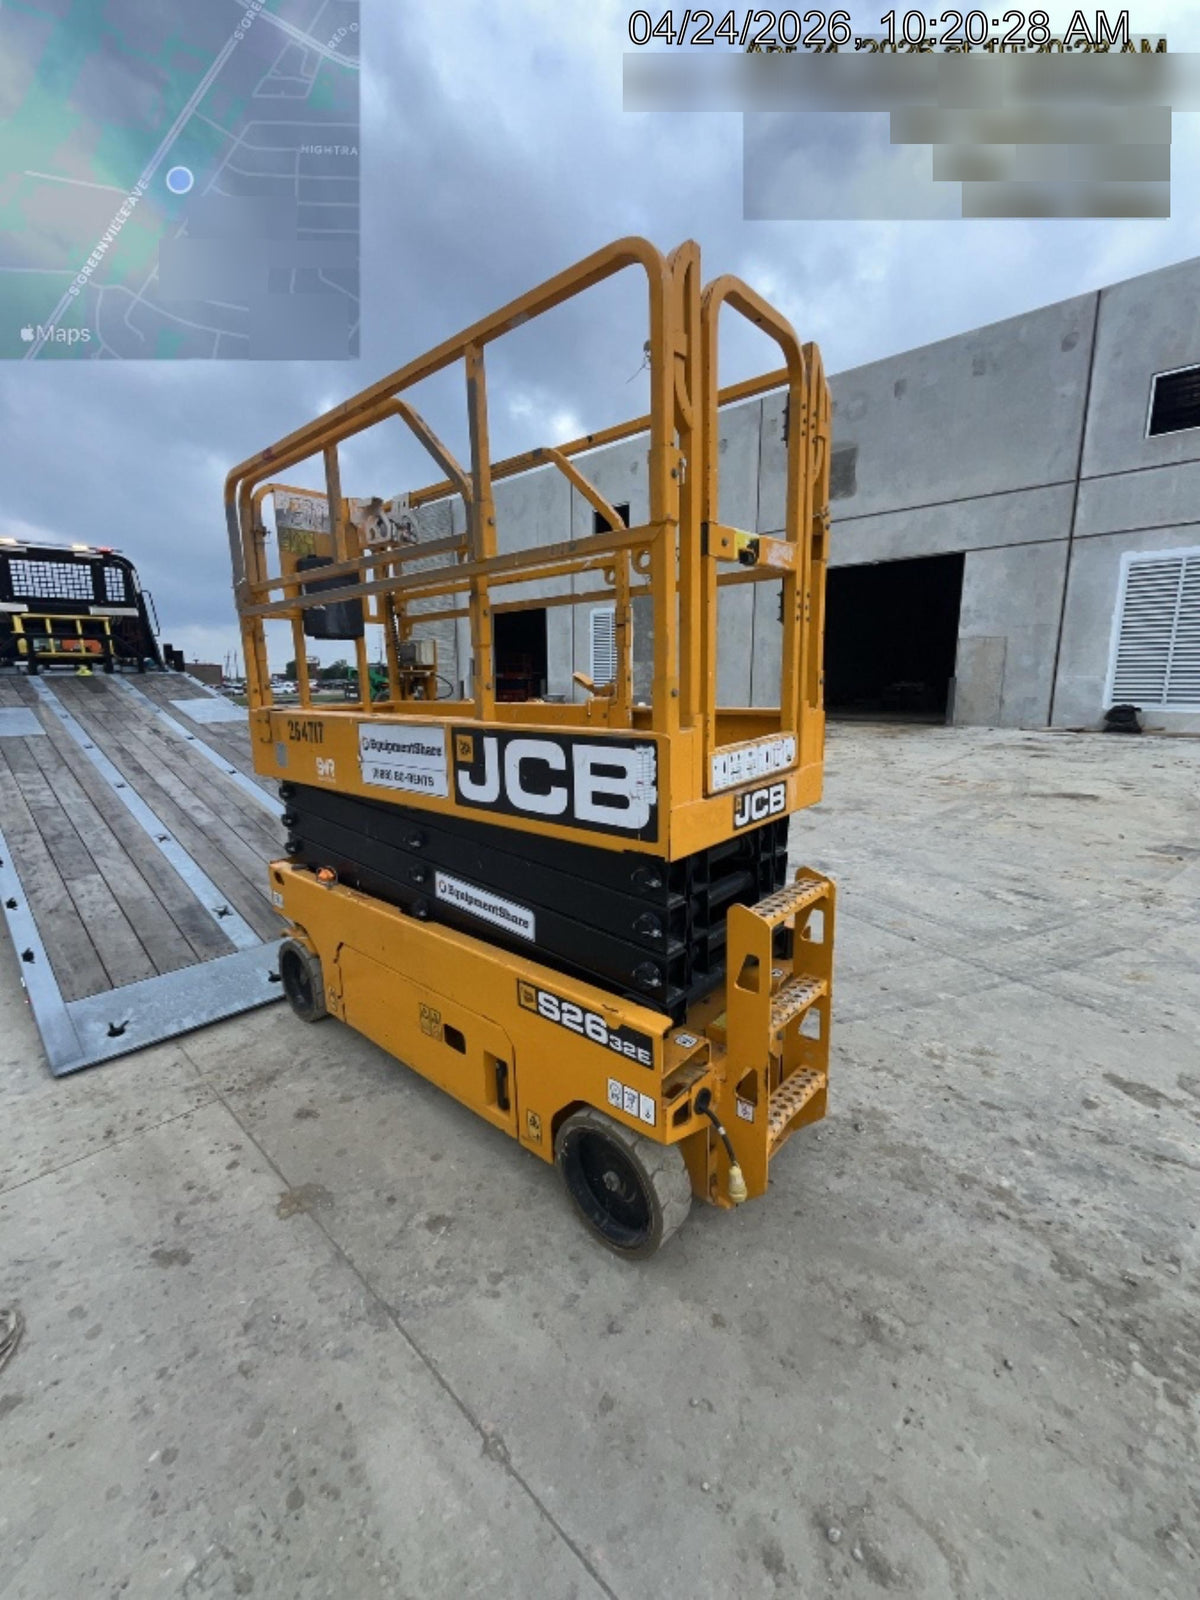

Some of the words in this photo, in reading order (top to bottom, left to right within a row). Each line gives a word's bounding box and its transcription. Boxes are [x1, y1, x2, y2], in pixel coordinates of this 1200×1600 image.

[457, 736, 656, 830] JCB
[735, 783, 786, 827] JCB
[447, 883, 529, 929] EquipmentShare
